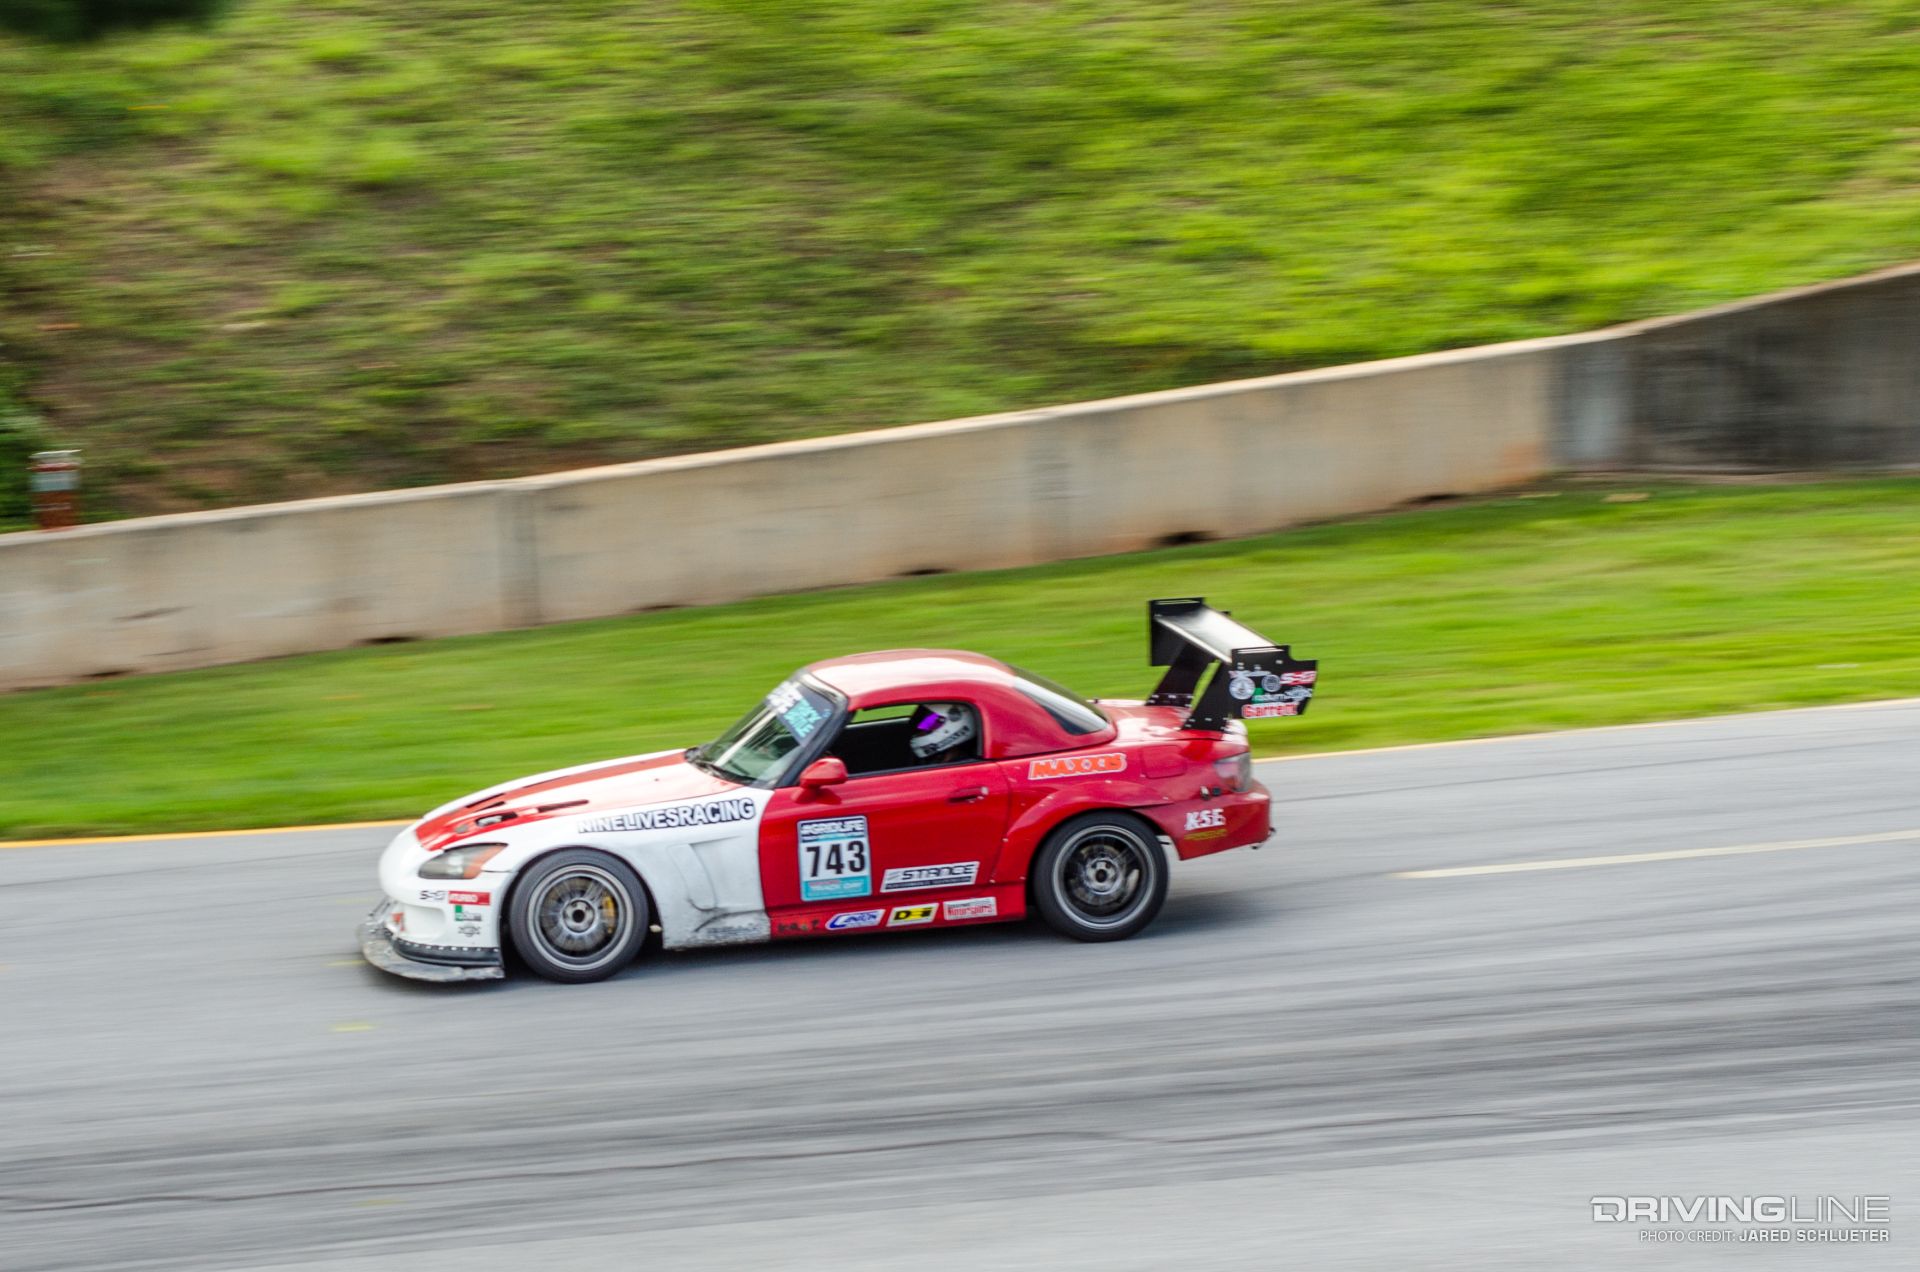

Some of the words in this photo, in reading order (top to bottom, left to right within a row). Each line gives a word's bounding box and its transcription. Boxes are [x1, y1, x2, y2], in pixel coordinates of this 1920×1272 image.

[1030, 753, 1126, 780] MAXXIS
[578, 798, 757, 833] NINELIVESRACING
[806, 840, 866, 878] 743
[902, 864, 976, 880] STANCE
